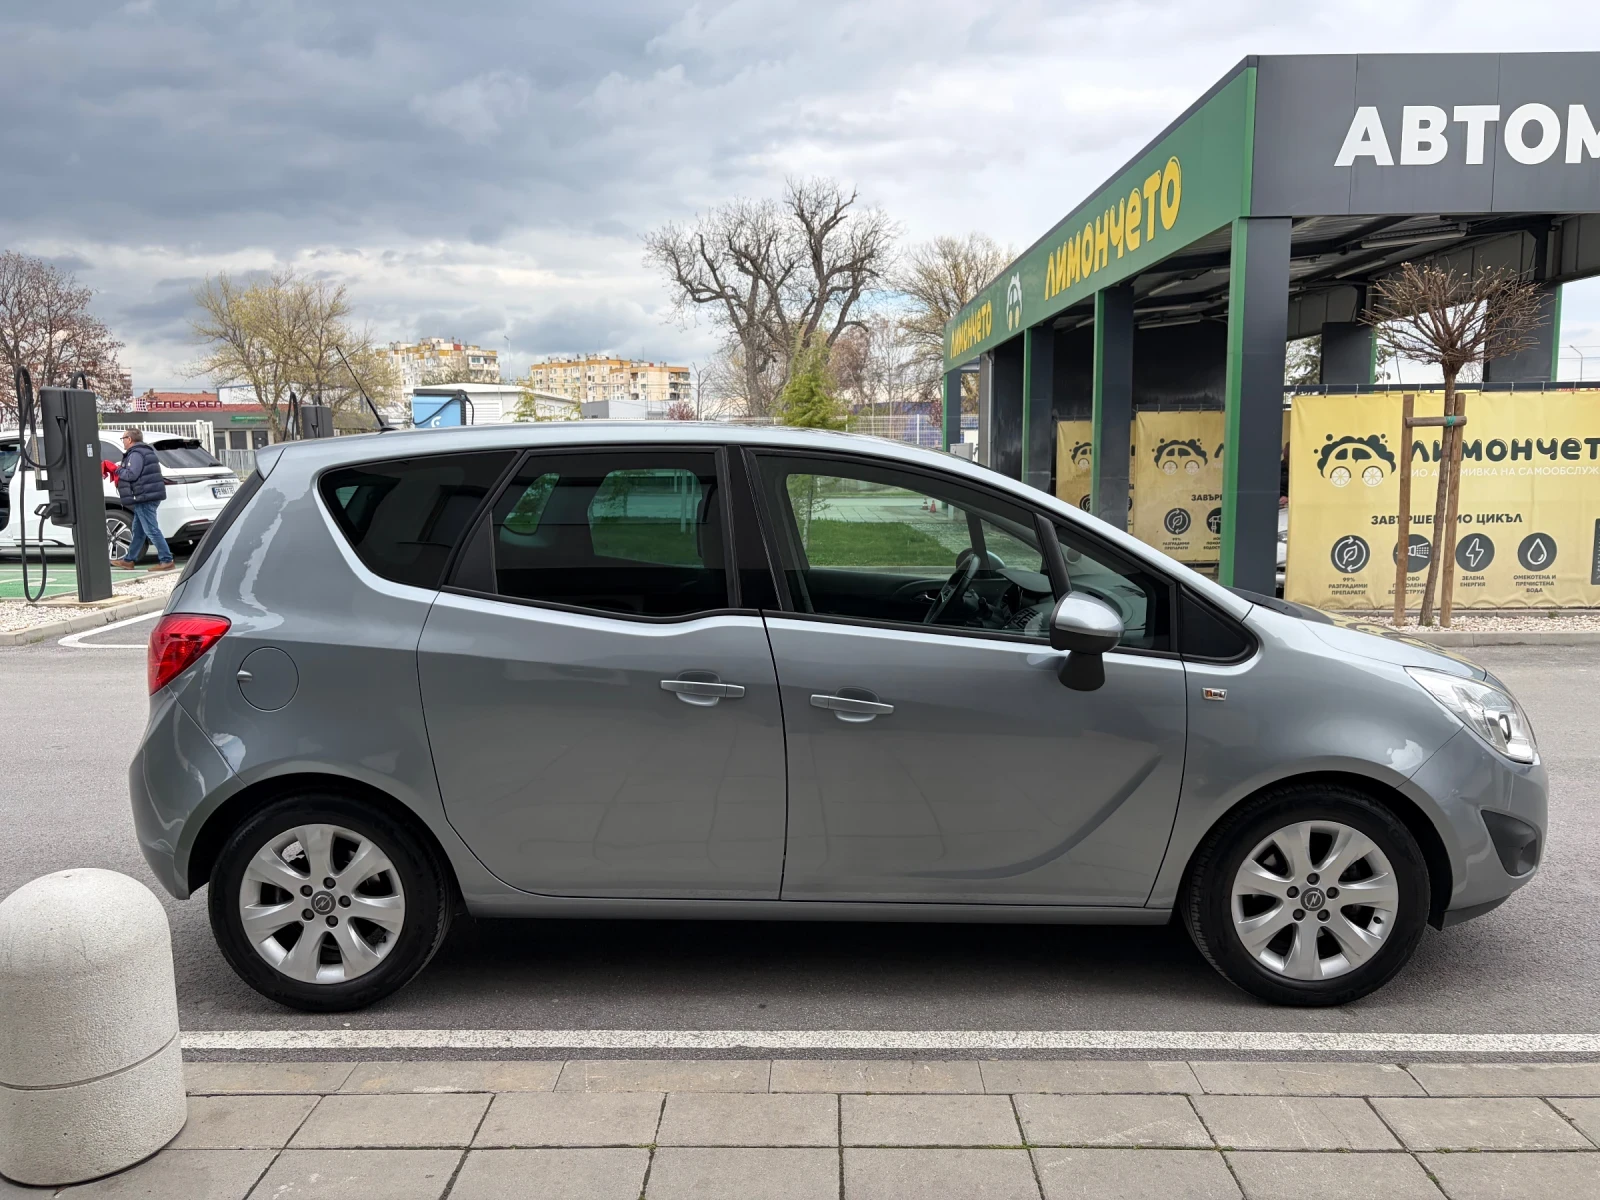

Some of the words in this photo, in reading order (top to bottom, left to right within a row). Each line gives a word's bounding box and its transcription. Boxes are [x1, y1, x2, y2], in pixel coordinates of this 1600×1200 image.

[150, 401, 223, 409] ТЕЛЕКАБЕЛ
[1431, 467, 1498, 477] АМИВКА
[1500, 468, 1516, 476] НА
[1518, 466, 1599, 477] САМООБСЛУЖ
[1476, 513, 1523, 525] ЦИКЪЛ
